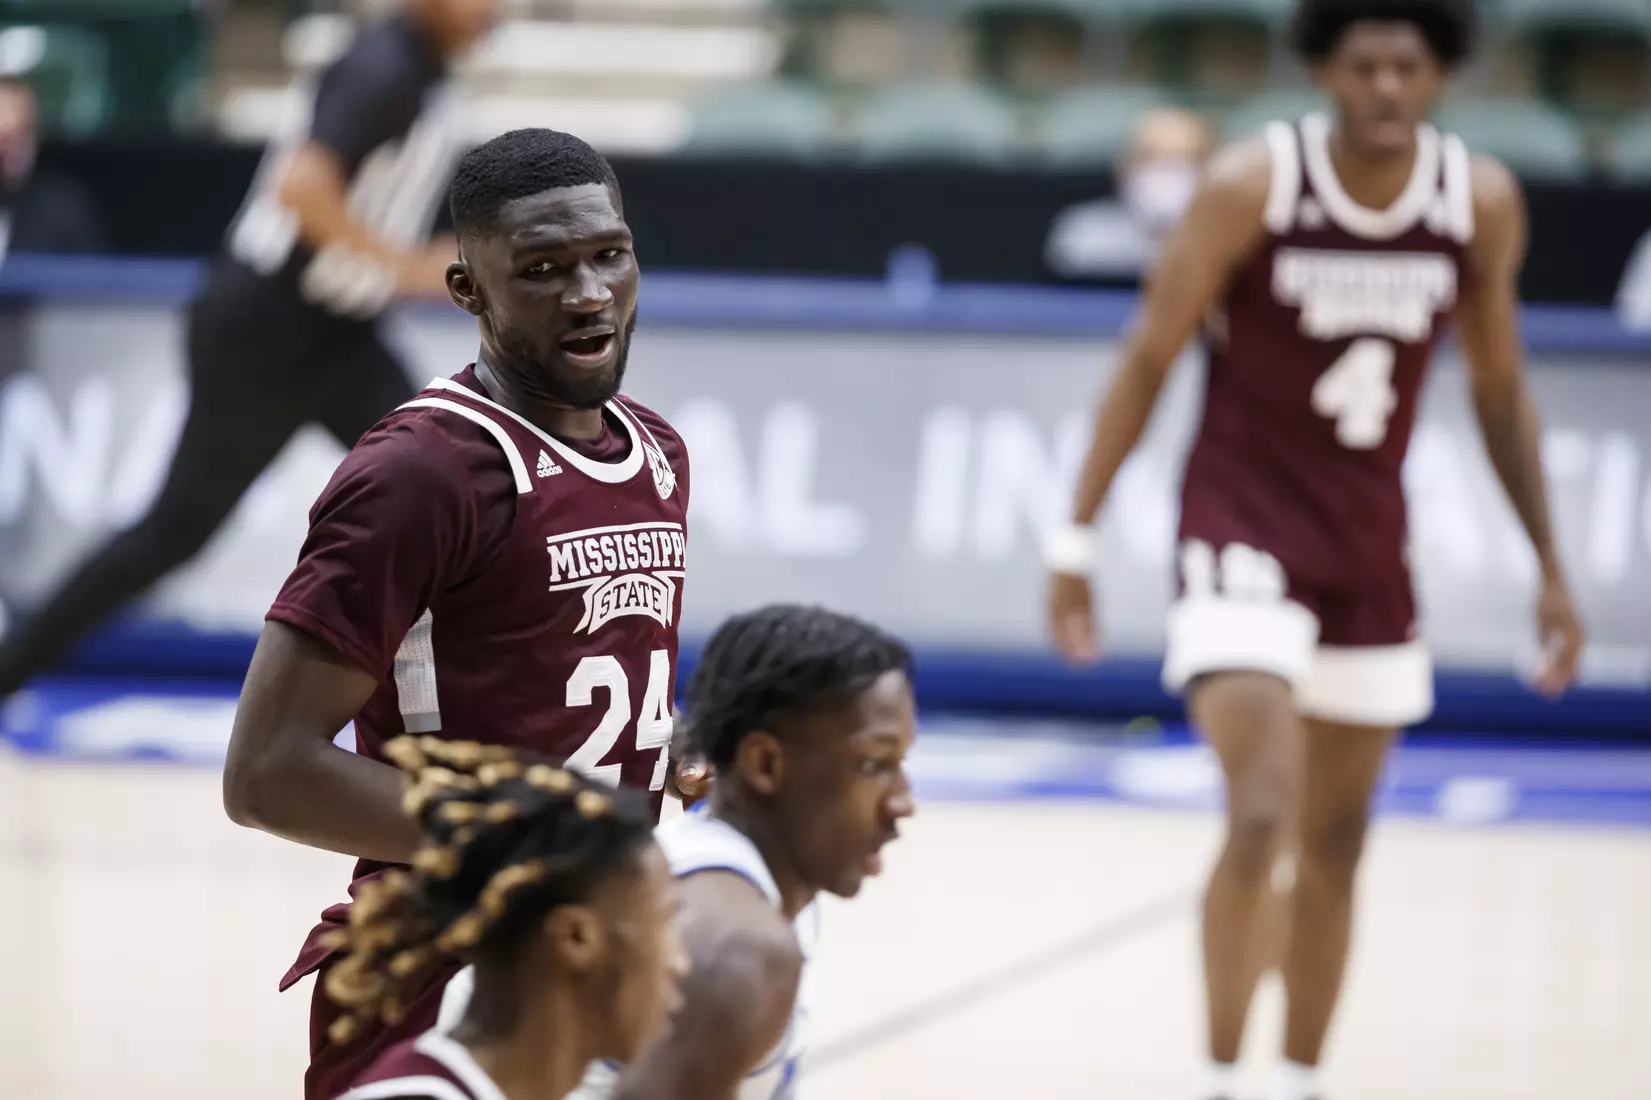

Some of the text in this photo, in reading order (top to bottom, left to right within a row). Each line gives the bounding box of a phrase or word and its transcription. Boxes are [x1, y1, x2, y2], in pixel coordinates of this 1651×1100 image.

[1311, 336, 1398, 449] 4
[599, 580, 662, 619] STATE
[563, 649, 673, 791] 24
